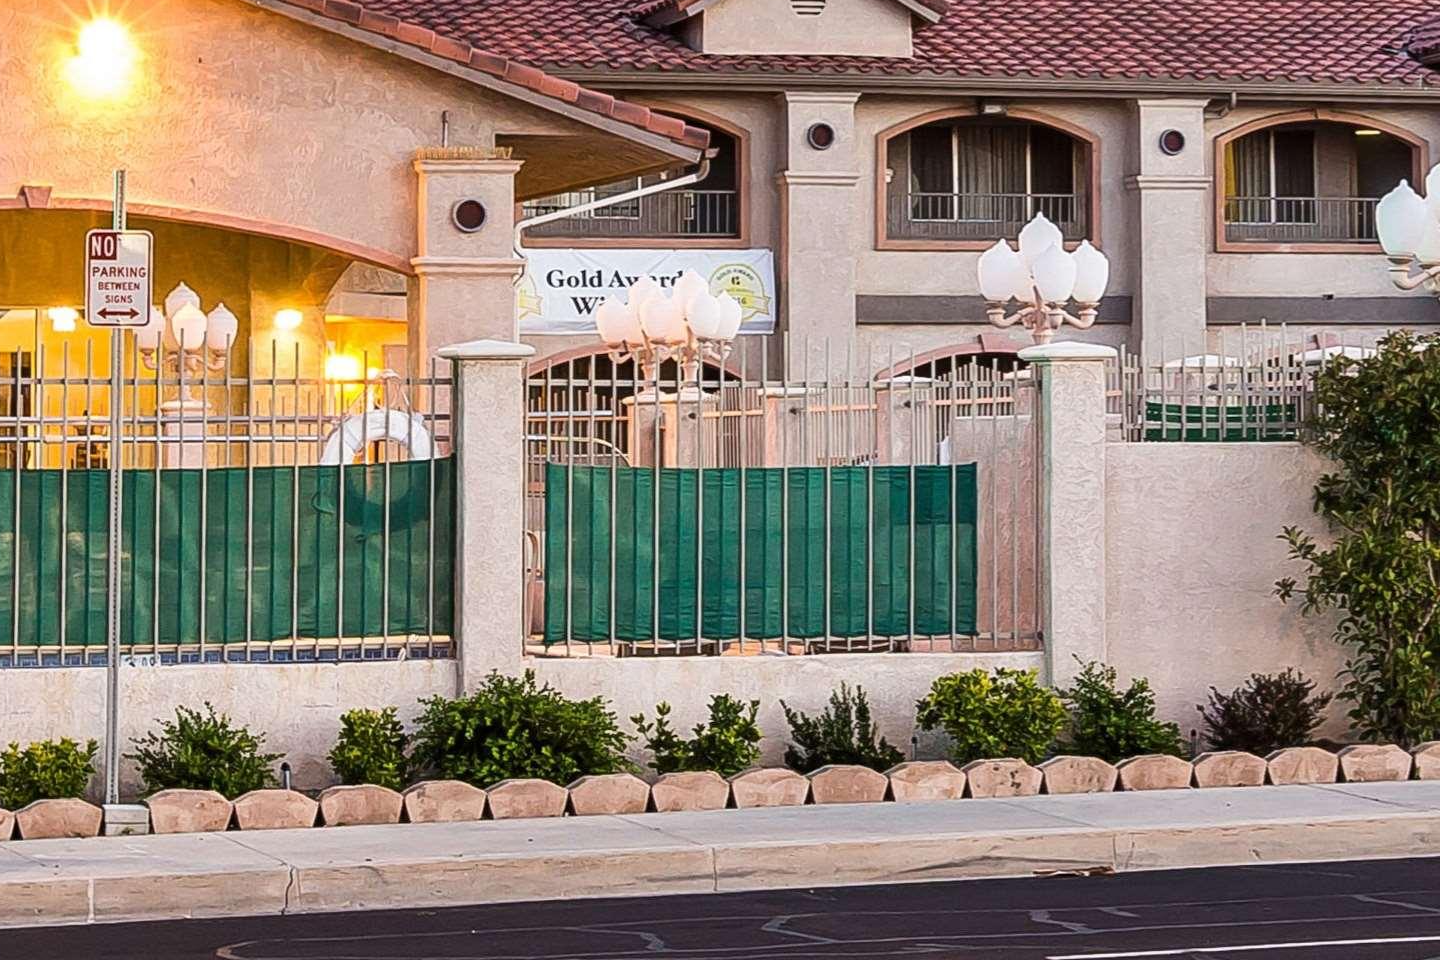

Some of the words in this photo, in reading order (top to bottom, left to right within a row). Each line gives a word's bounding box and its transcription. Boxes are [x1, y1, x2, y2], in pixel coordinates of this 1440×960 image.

[91, 235, 114, 257] NO
[92, 266, 147, 278] PARKING
[546, 269, 603, 288] Gold
[98, 281, 140, 291] BETWEEN
[105, 294, 133, 304] SIGNS
